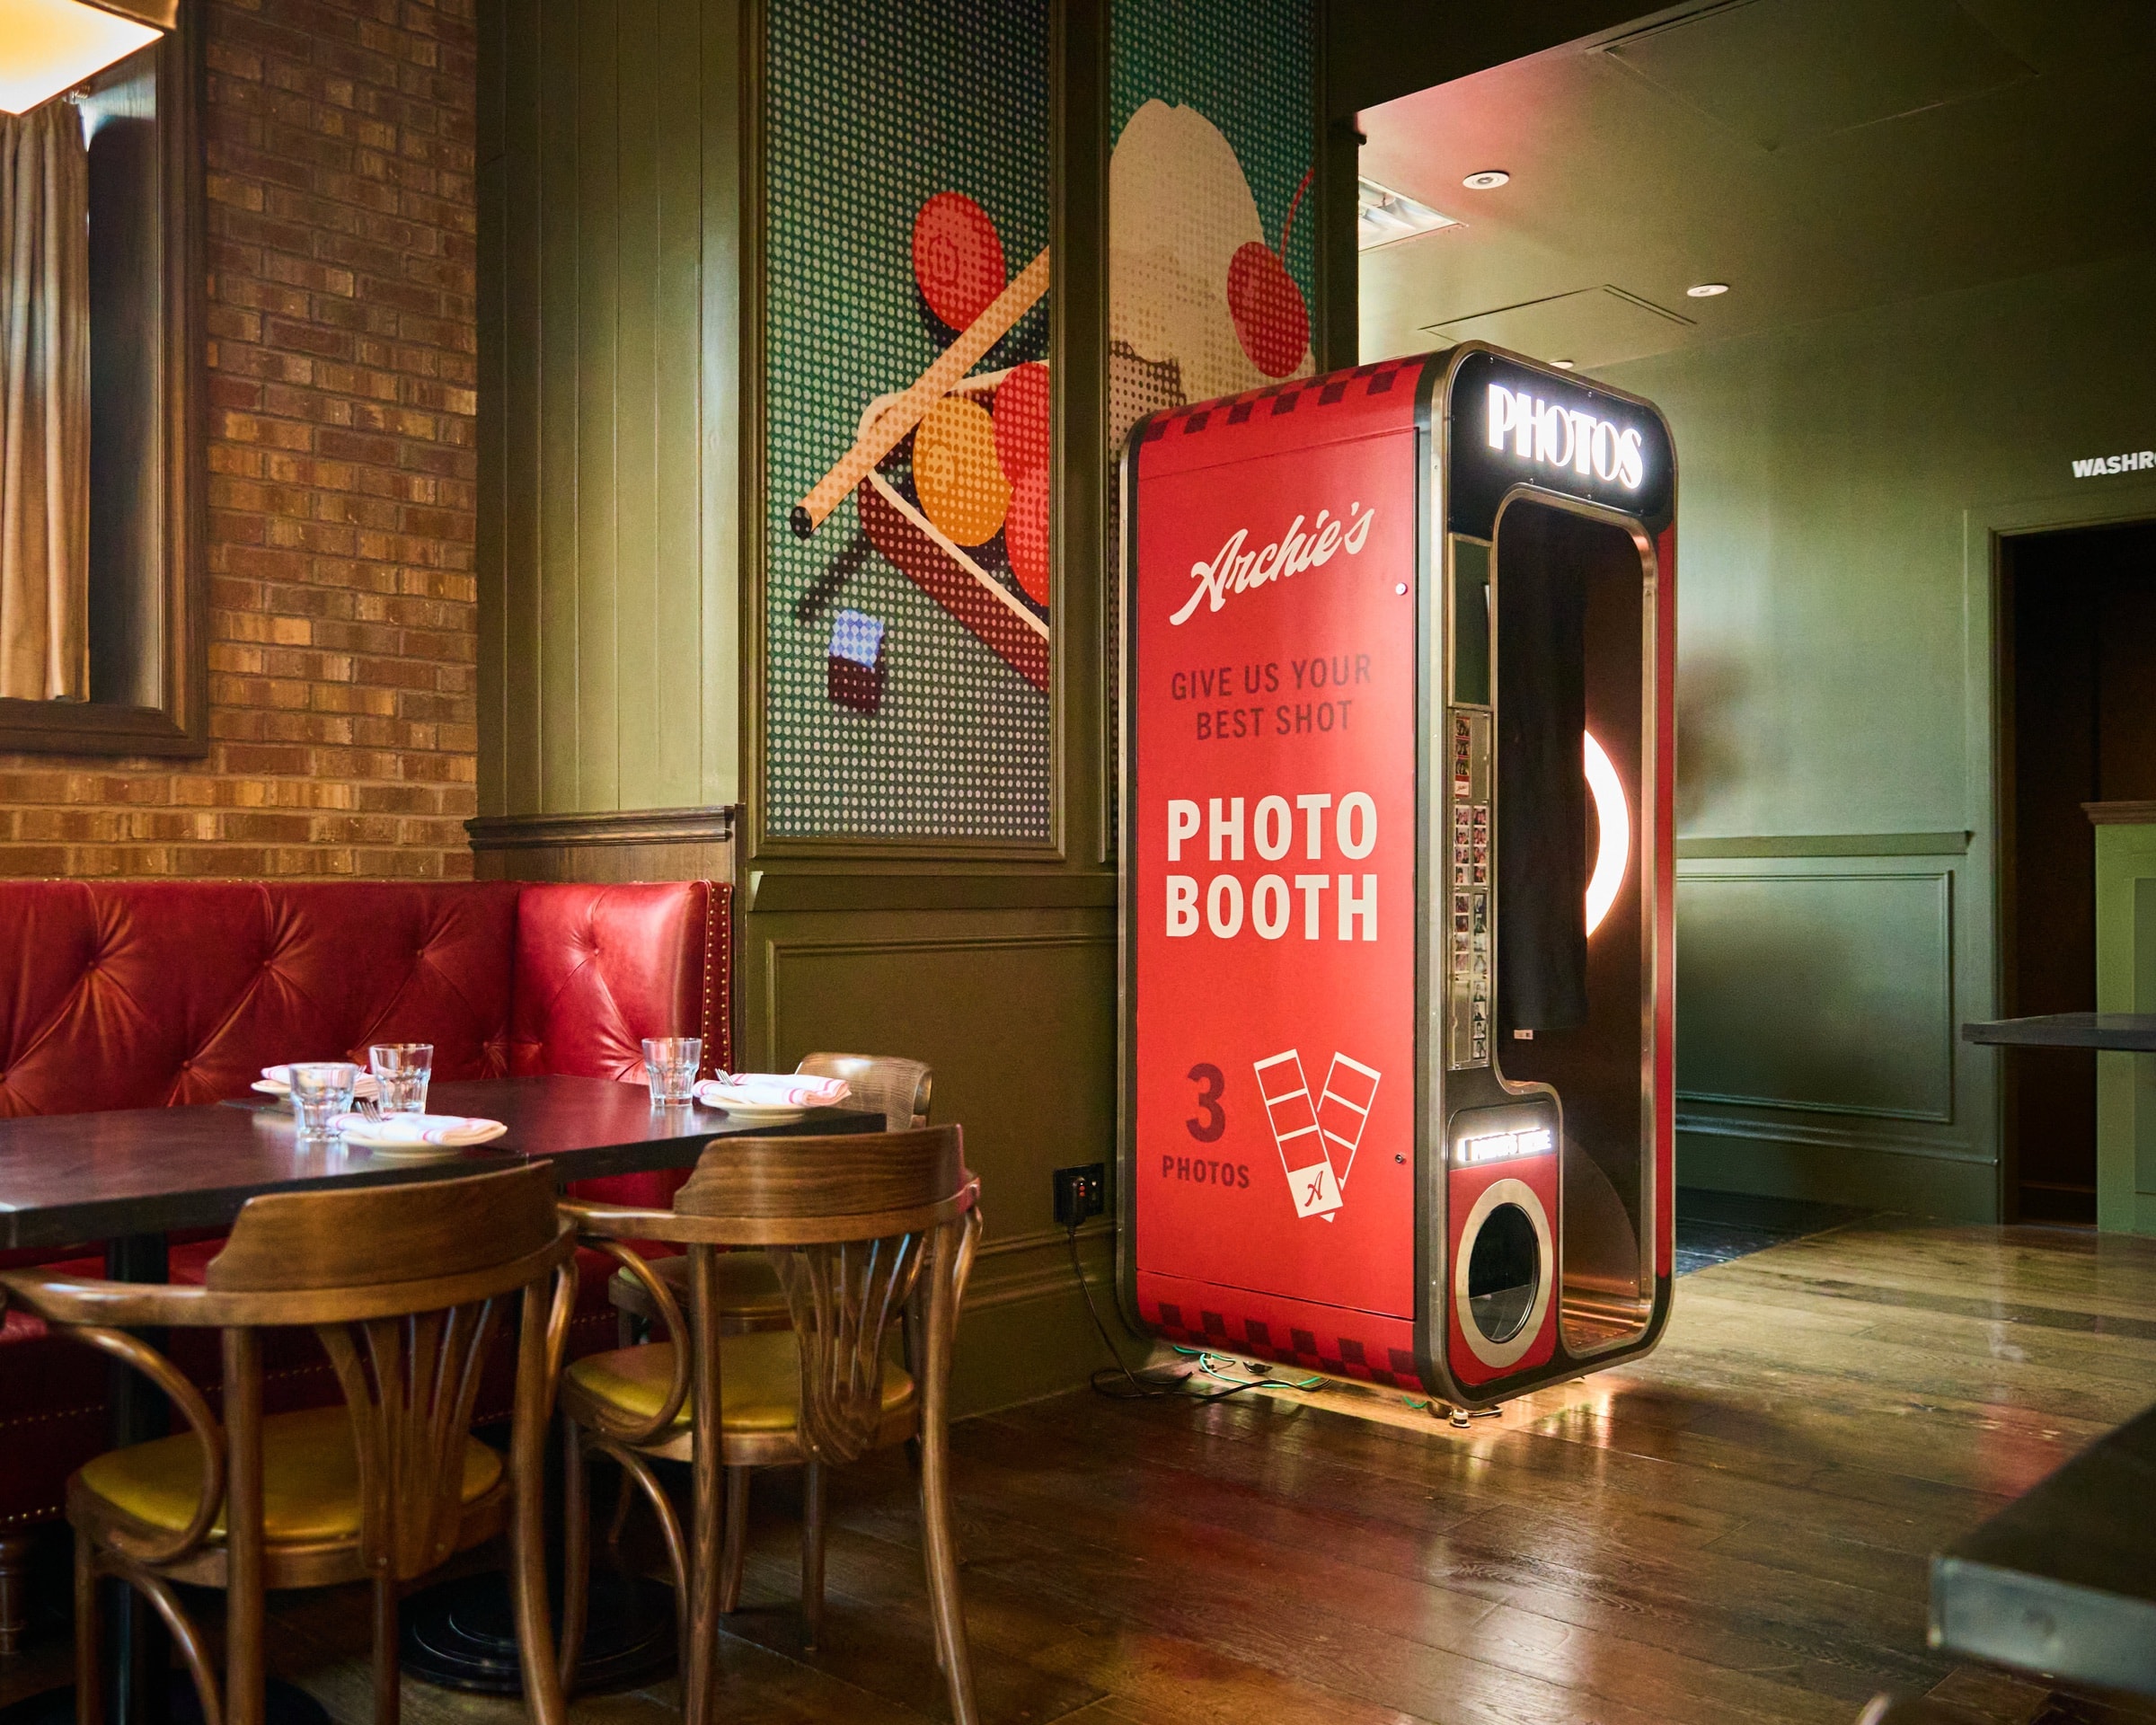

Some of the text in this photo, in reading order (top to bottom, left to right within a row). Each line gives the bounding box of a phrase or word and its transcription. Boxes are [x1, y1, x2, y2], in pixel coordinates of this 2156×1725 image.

[1489, 384, 1644, 490] PHOTOS
[1169, 501, 1375, 626] Archie's
[1171, 653, 1373, 701] GIVE US YOUR
[1196, 700, 1353, 741] BEST SHOT
[1167, 791, 1378, 862] PHOTO
[1166, 873, 1378, 942] BOOTH
[1185, 1062, 1226, 1144] 3
[1162, 1154, 1250, 1190] PHOTOS
